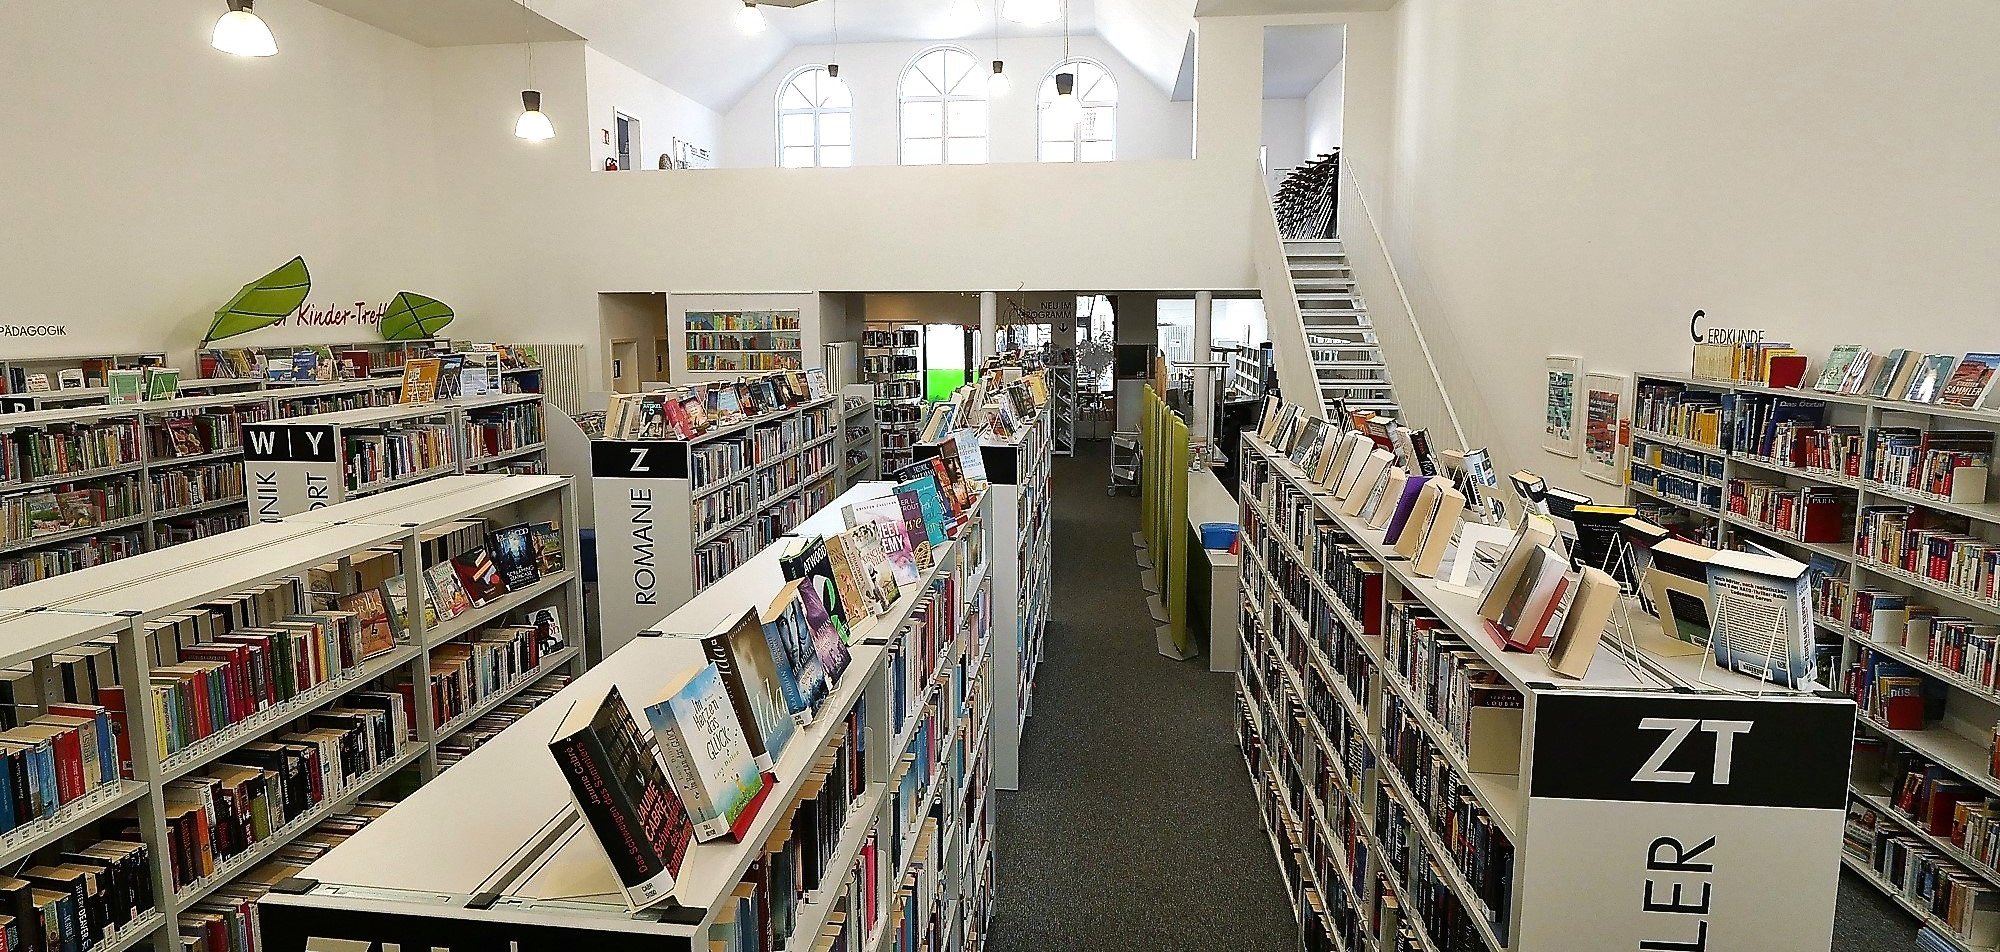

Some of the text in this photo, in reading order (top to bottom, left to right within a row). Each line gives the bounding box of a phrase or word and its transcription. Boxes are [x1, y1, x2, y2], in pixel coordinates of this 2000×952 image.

[1041, 302, 1072, 310] NEU IM
[1691, 309, 1705, 342] C
[1708, 329, 1764, 344] ERDKUNDE
[250, 431, 323, 455] W Y
[630, 448, 649, 472] Z
[255, 471, 283, 522] NIK
[630, 488, 657, 605] ROMANE
[803, 544, 827, 573] ATWOOD
[692, 700, 720, 732] Herzen
[756, 677, 788, 743] Ida
[1631, 718, 1754, 784] ZT
[579, 776, 600, 806] Jaume
[637, 779, 660, 826] JAUME
[576, 741, 648, 874] Das Schweigen des Sammlers
[1639, 834, 1718, 952] LER
[78, 907, 89, 938] DEAVER
